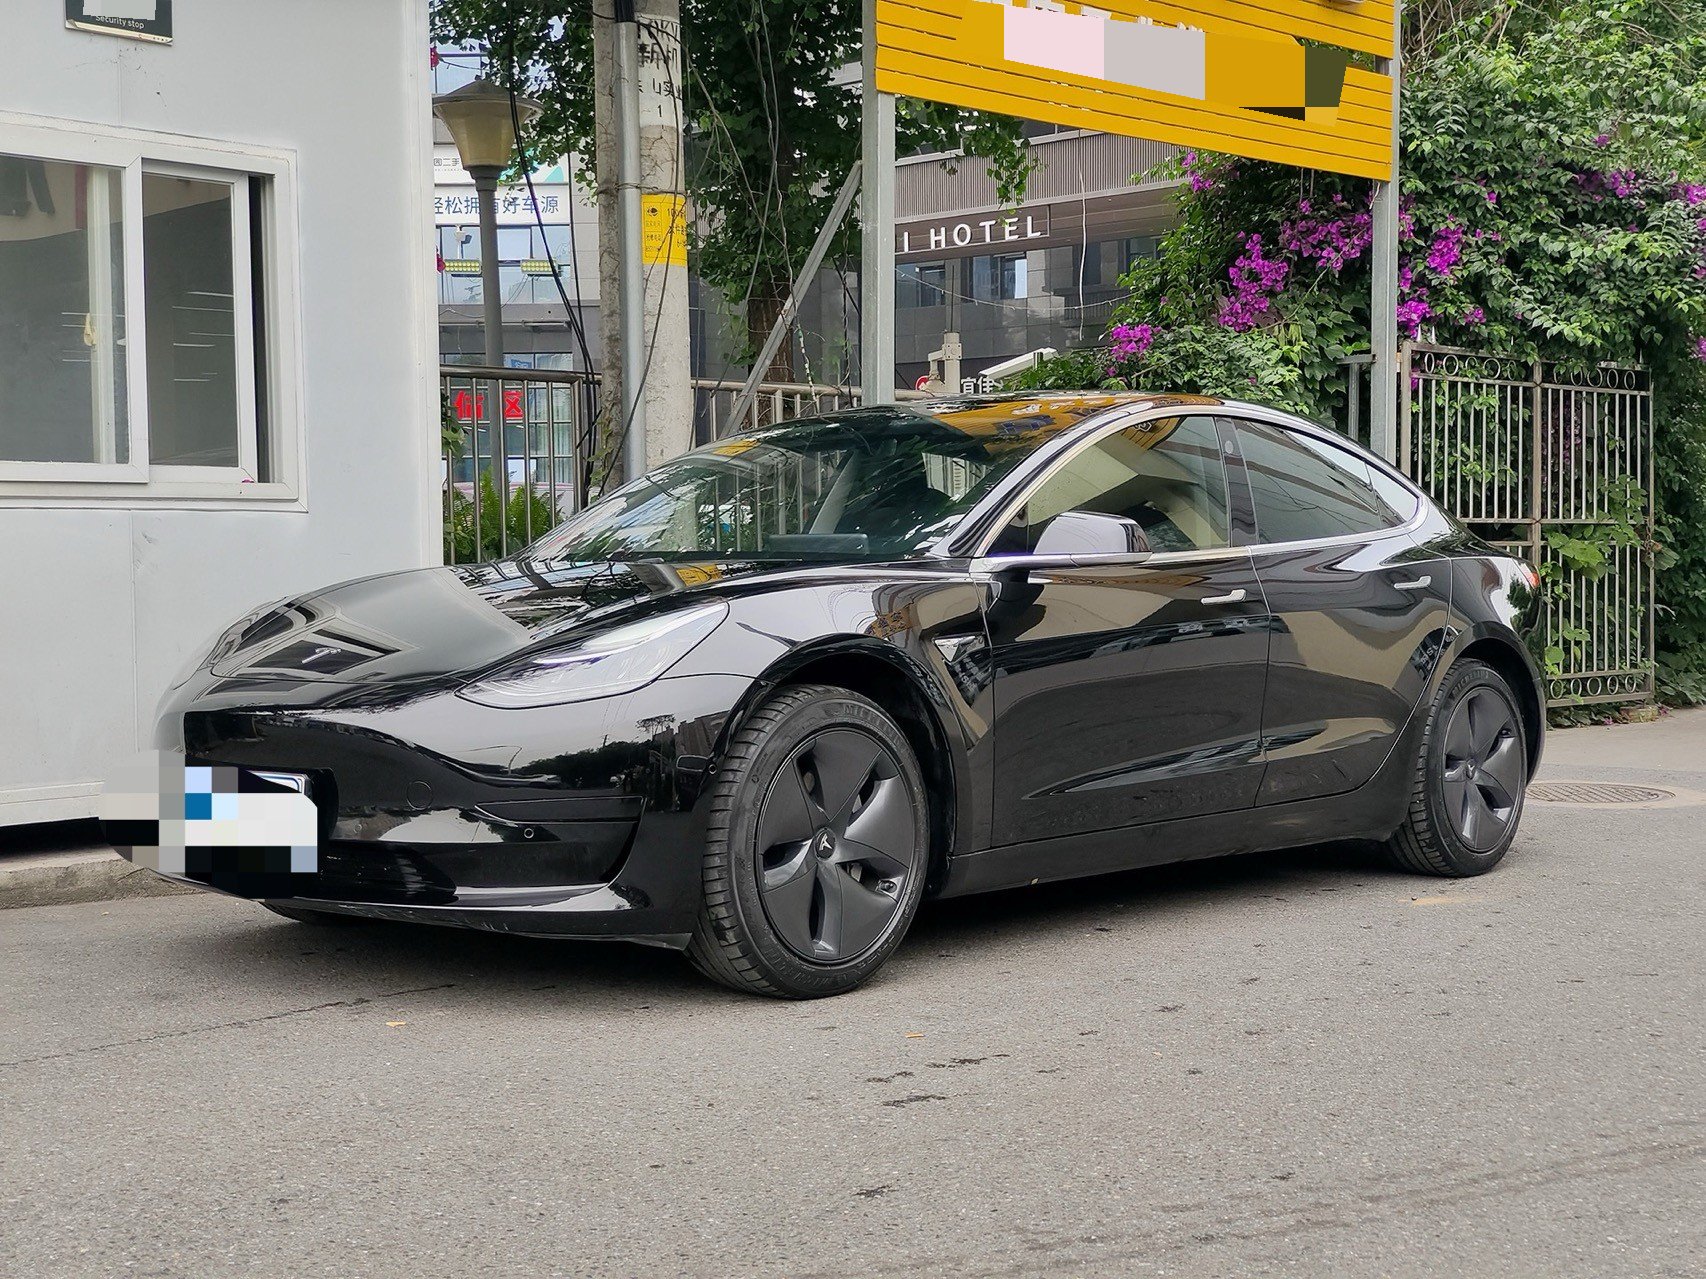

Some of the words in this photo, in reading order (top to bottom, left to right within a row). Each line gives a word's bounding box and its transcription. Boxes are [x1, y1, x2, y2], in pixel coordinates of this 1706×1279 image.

[95, 15, 127, 27] Security
[128, 19, 145, 30] stop
[929, 215, 1042, 250] HOTEL
